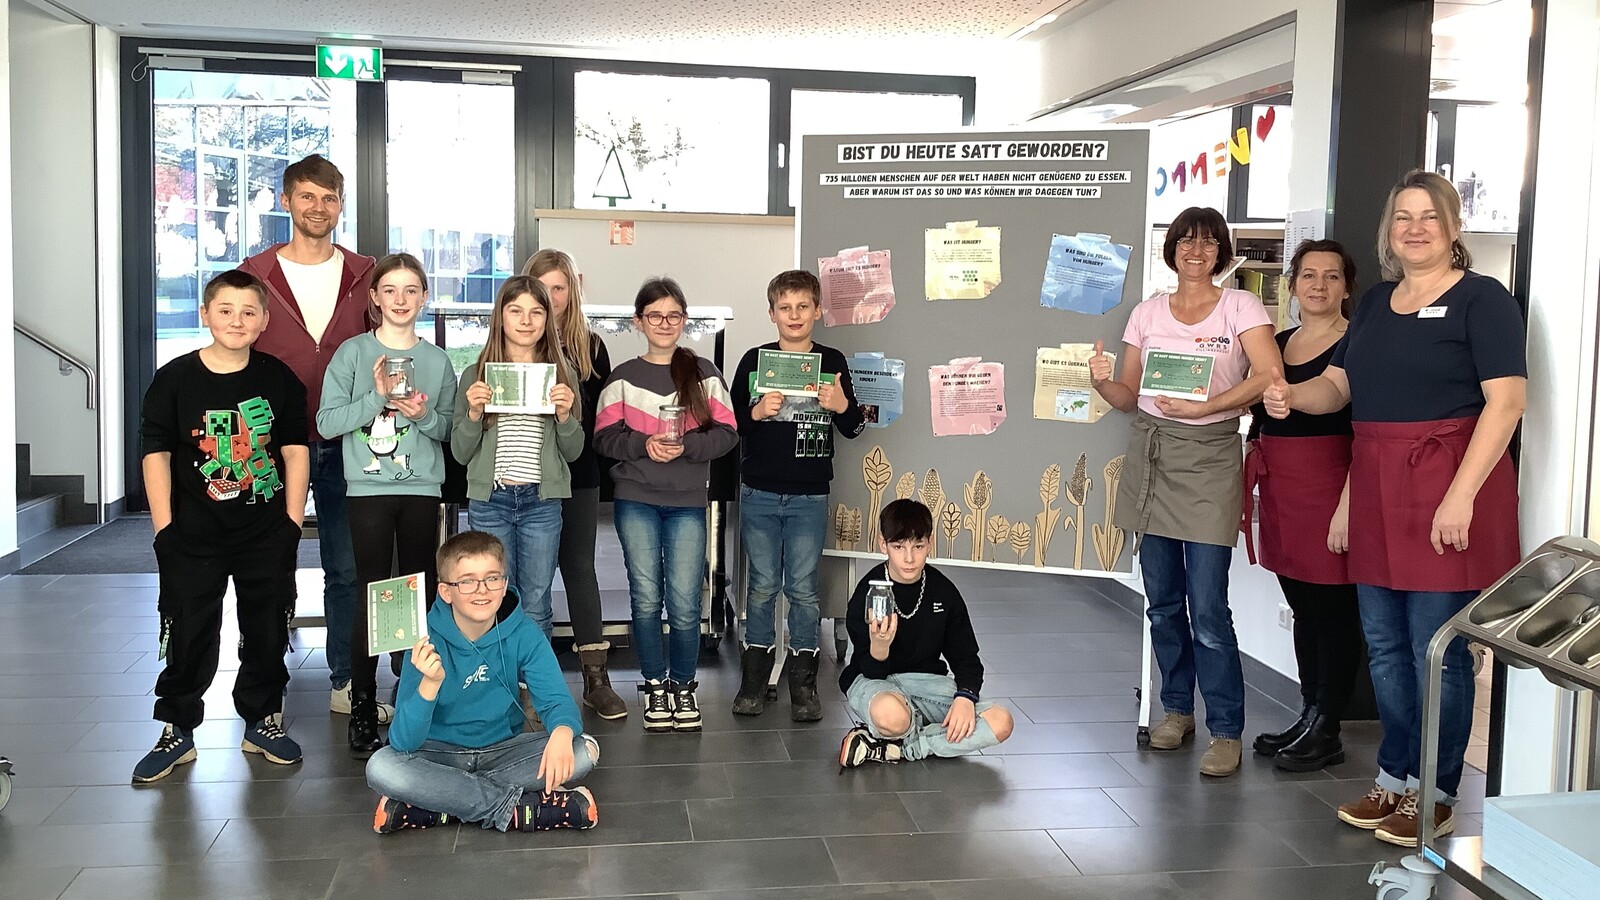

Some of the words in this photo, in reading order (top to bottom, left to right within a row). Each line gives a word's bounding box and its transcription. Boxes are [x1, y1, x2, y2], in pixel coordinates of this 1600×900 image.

[843, 146, 875, 160] BIST
[880, 145, 901, 159] DU
[906, 144, 956, 159] HEUTE
[961, 143, 1002, 158] SATT
[1006, 142, 1105, 158] GEWORDEN?
[825, 175, 839, 183] 735
[841, 175, 877, 183] MILLONEN
[880, 174, 920, 182] MENSCHEN
[923, 174, 939, 182] AUF
[941, 174, 956, 182] DER
[982, 173, 1010, 181] HABEN
[1012, 173, 1036, 181] NICHT
[1039, 171, 1081, 181] GENÜGEND
[1085, 173, 1095, 181] ZU
[1098, 173, 1127, 181] ESSEN.
[850, 188, 870, 196] ABER
[872, 188, 900, 196] WARUM
[902, 188, 914, 196] IST
[916, 188, 932, 196] DAS
[934, 188, 944, 196] SO
[946, 188, 962, 196] UND
[984, 186, 1016, 196] KÖNNEN
[1018, 188, 1032, 196] WIR
[1035, 188, 1072, 196] DAGEGEN
[1076, 188, 1098, 196] TUN?
